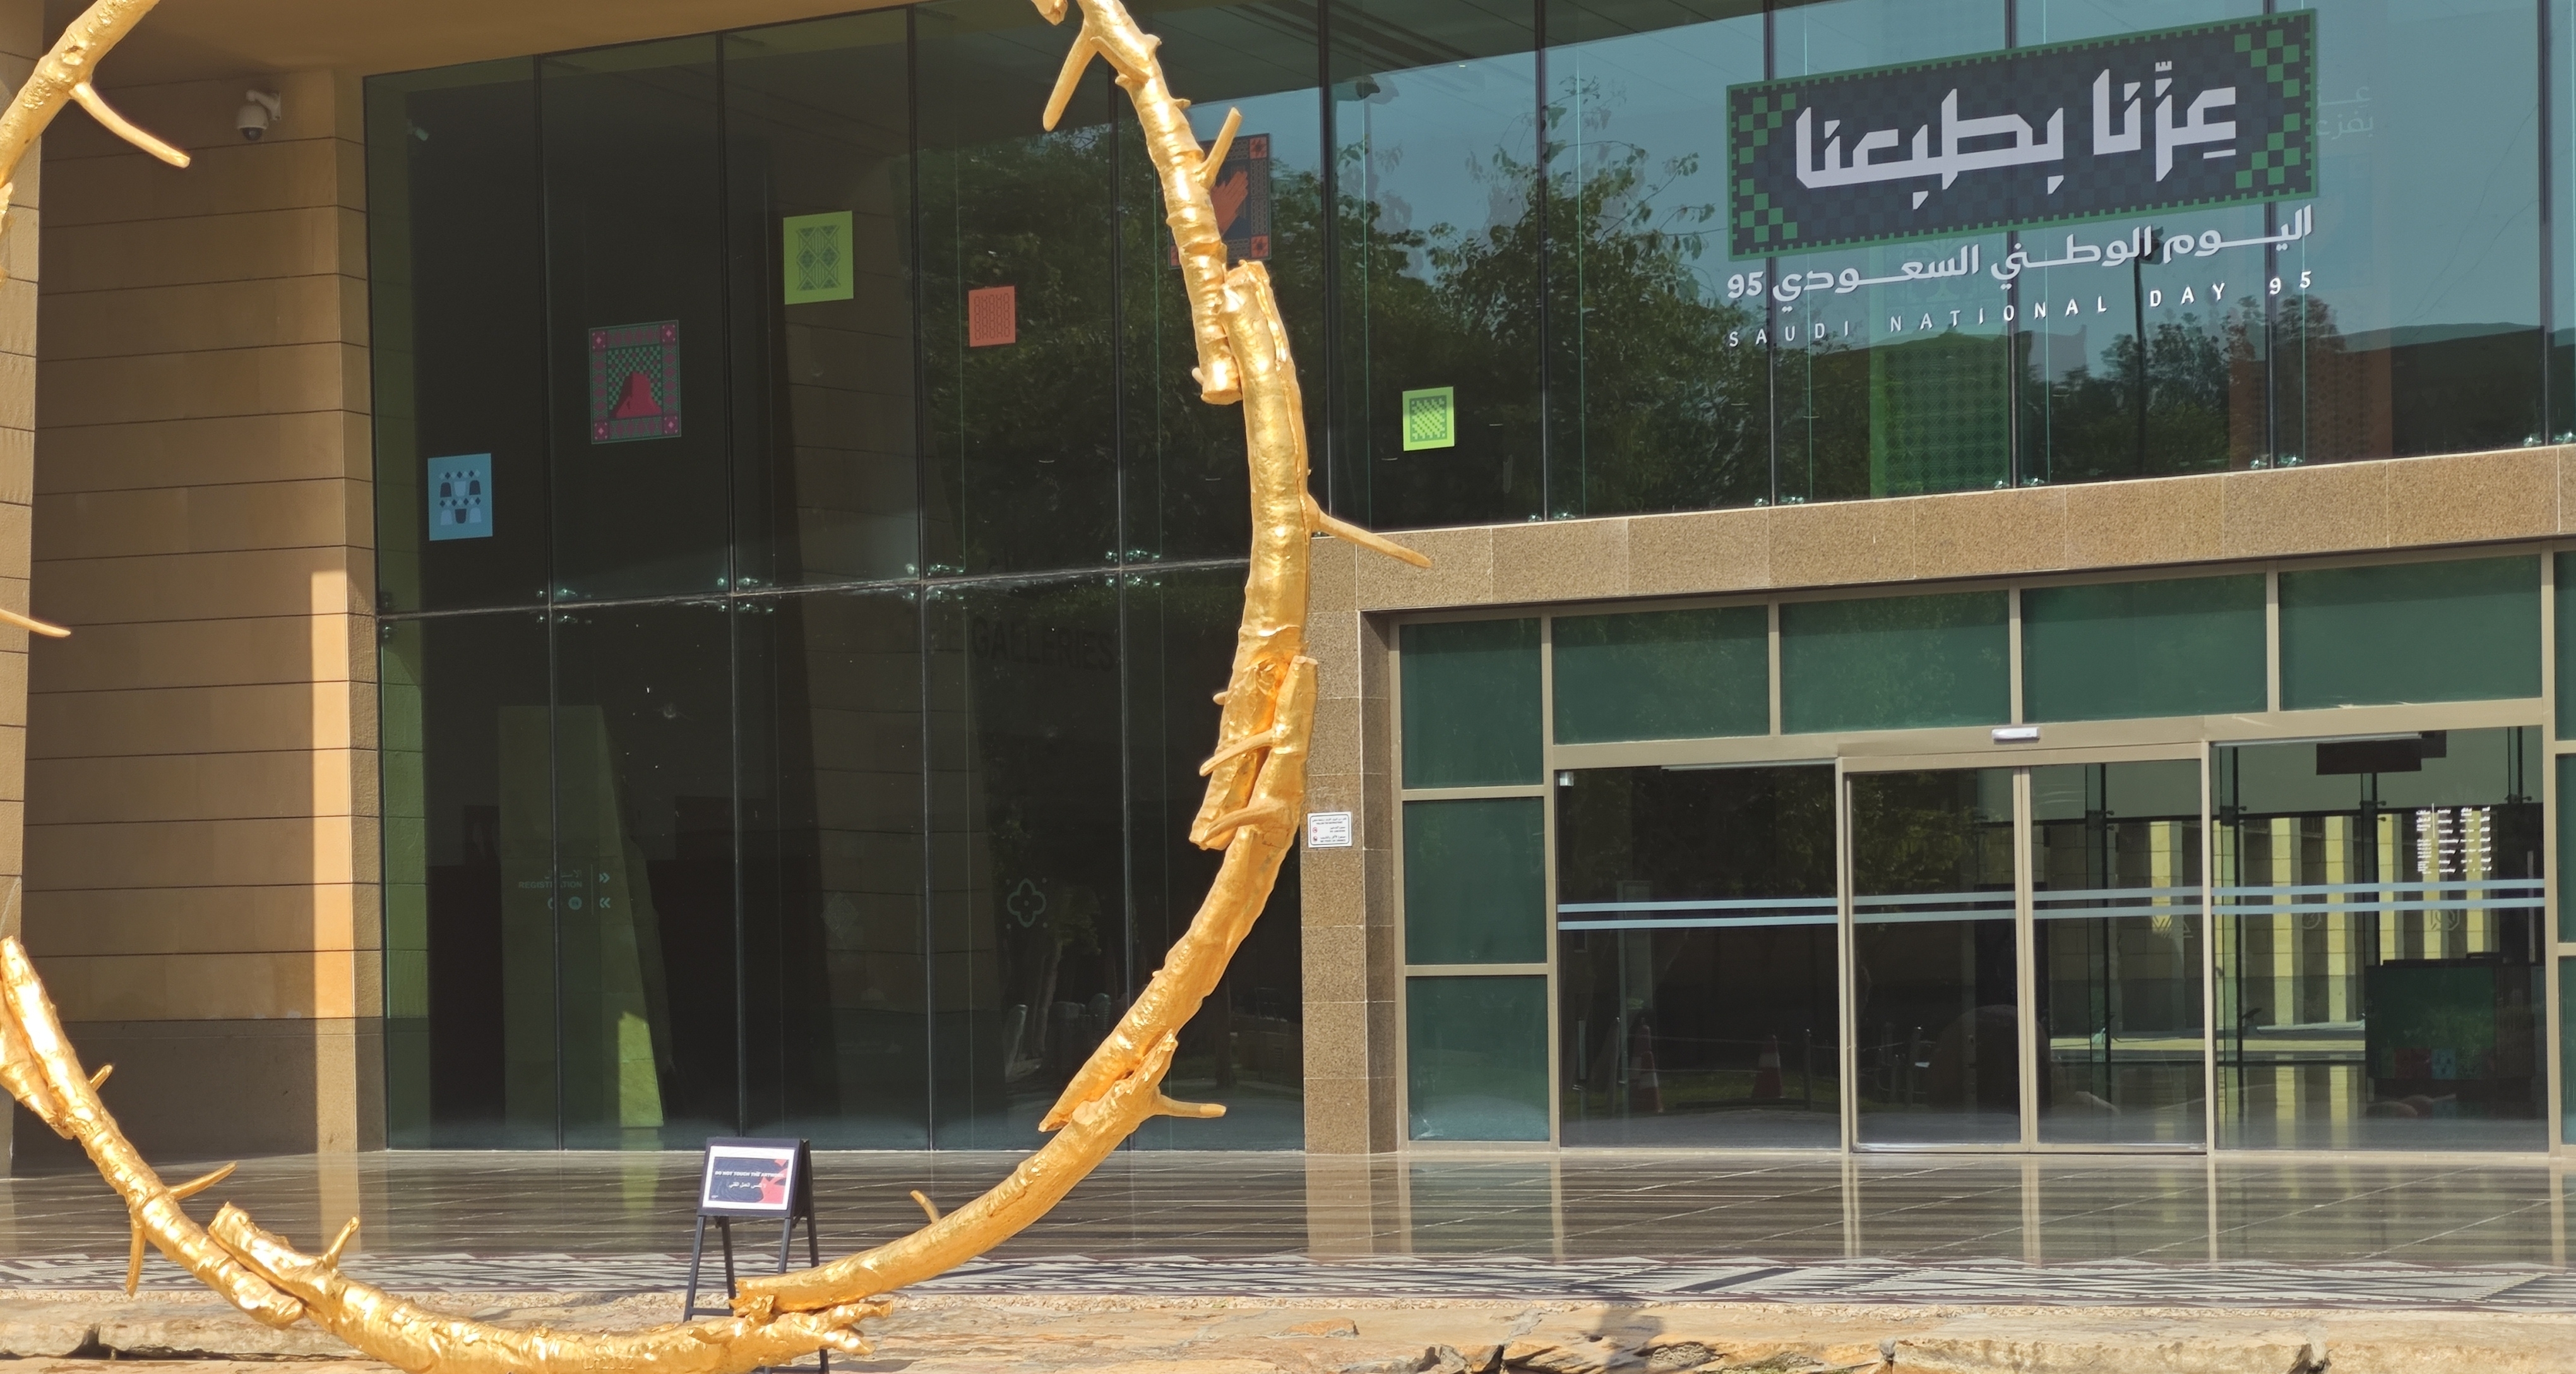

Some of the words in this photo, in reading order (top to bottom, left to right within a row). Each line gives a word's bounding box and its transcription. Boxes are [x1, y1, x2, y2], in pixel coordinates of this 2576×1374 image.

[1796, 89, 2063, 209] بطبعنا
[1991, 225, 2152, 290] الوطني
[2164, 205, 2312, 263] اليوم
[1727, 272, 1764, 299] 95
[1730, 320, 1849, 347] SAUDI
[1890, 296, 2108, 332] NATIONAL
[2149, 283, 2226, 308] DAY
[2269, 270, 2311, 296] 95
[1773, 244, 1979, 313] السعودي
[971, 615, 1117, 672] GALLERIES
